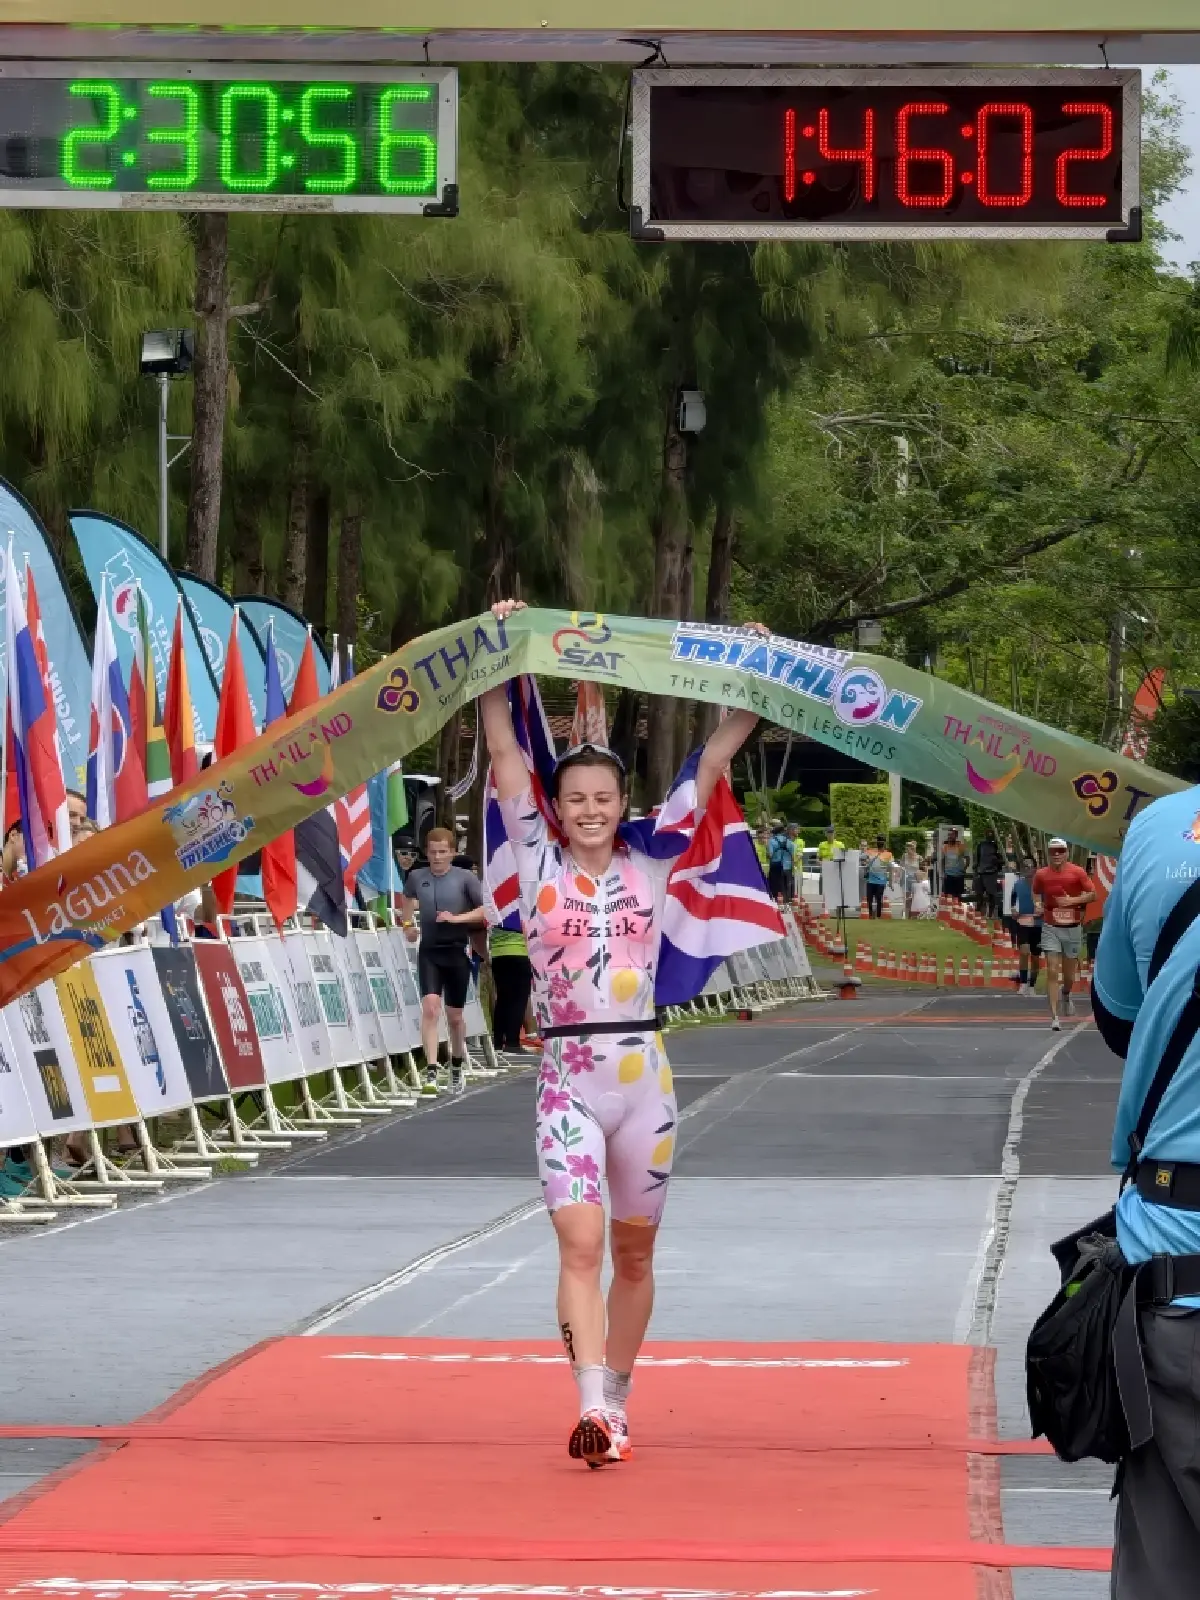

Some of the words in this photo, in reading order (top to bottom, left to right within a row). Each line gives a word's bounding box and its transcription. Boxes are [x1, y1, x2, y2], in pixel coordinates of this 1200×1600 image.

[60, 81, 438, 194] 2:30:56
[781, 102, 1113, 208] 1:46:02
[413, 619, 510, 692] THAI
[557, 647, 626, 671] SAT
[671, 632, 924, 734] TRIATHLON
[247, 711, 353, 788] THAILAND
[670, 674, 709, 693] THE
[721, 682, 769, 710] RACE
[780, 703, 805, 721] OF
[812, 715, 899, 761] LEGENDS
[943, 714, 1058, 778] THAILAND
